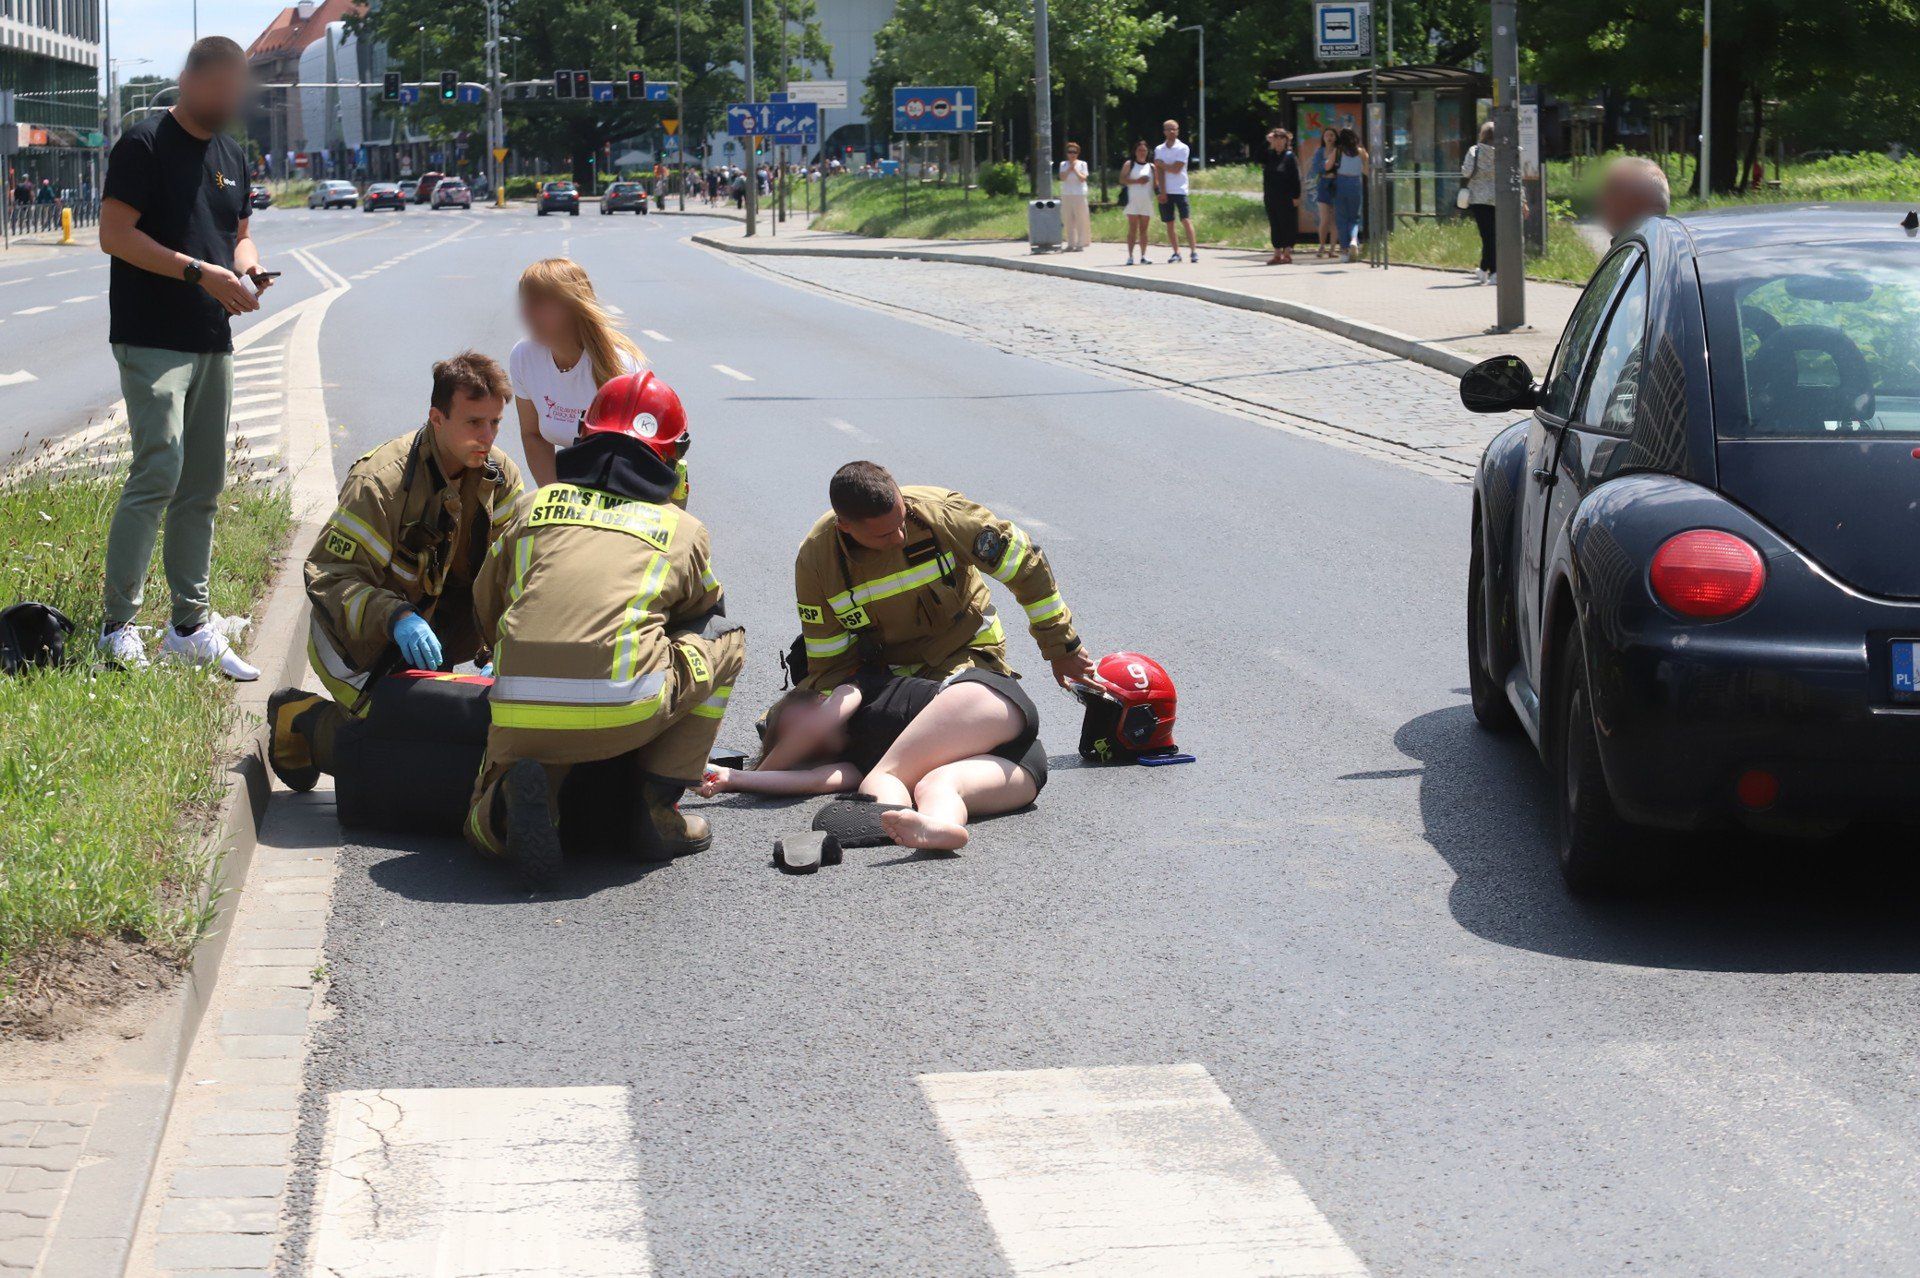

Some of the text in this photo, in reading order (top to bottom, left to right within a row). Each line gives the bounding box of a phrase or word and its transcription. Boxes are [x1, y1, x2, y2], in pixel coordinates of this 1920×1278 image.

[329, 535, 352, 555] PSP
[840, 611, 863, 627] PSP
[687, 649, 706, 676] PSP
[1126, 663, 1149, 690] 9
[1896, 673, 1912, 685] PL
